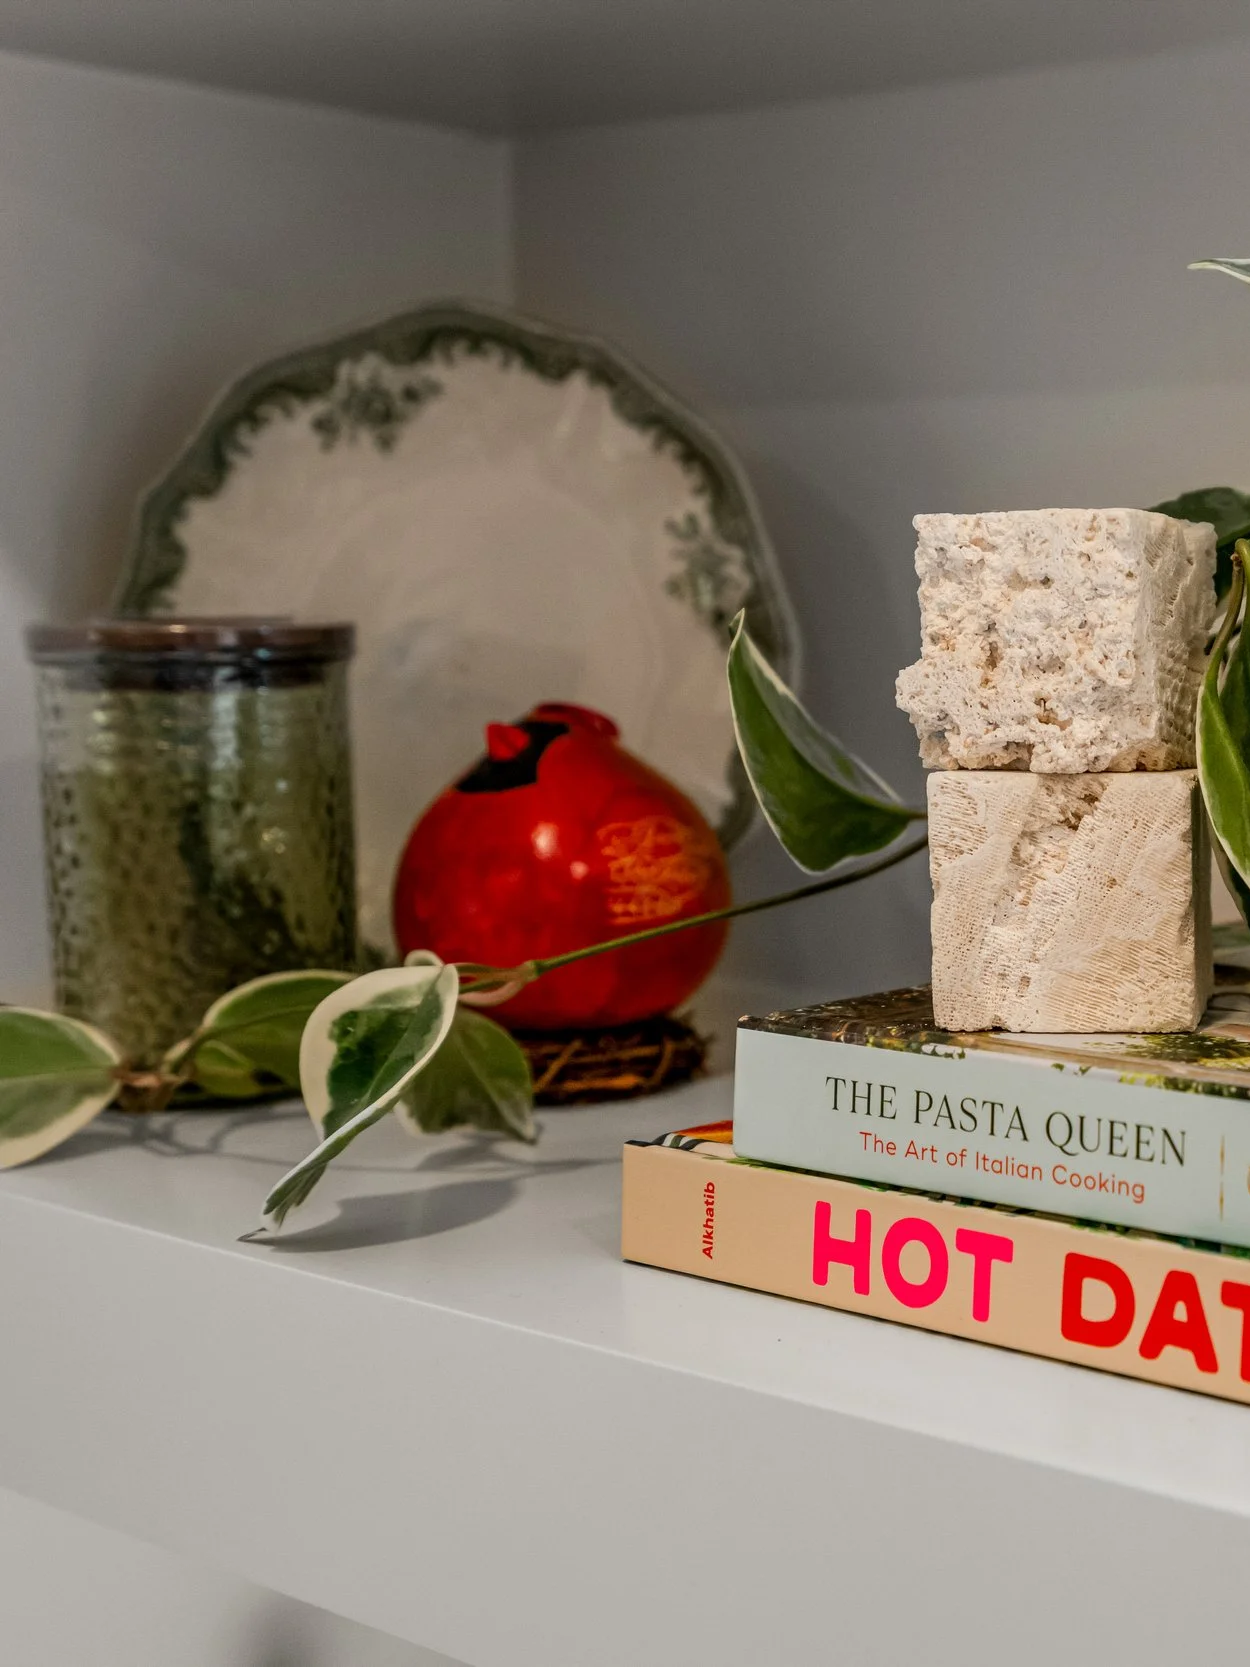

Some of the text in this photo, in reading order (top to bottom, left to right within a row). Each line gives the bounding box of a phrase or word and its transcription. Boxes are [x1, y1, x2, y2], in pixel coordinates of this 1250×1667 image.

[826, 1076, 1187, 1168] THE PASTA QUEEN
[859, 1131, 1146, 1204] The Art of Italian Cooking
[702, 1181, 715, 1260] Alkhatib
[812, 1200, 1014, 1323] HOT
